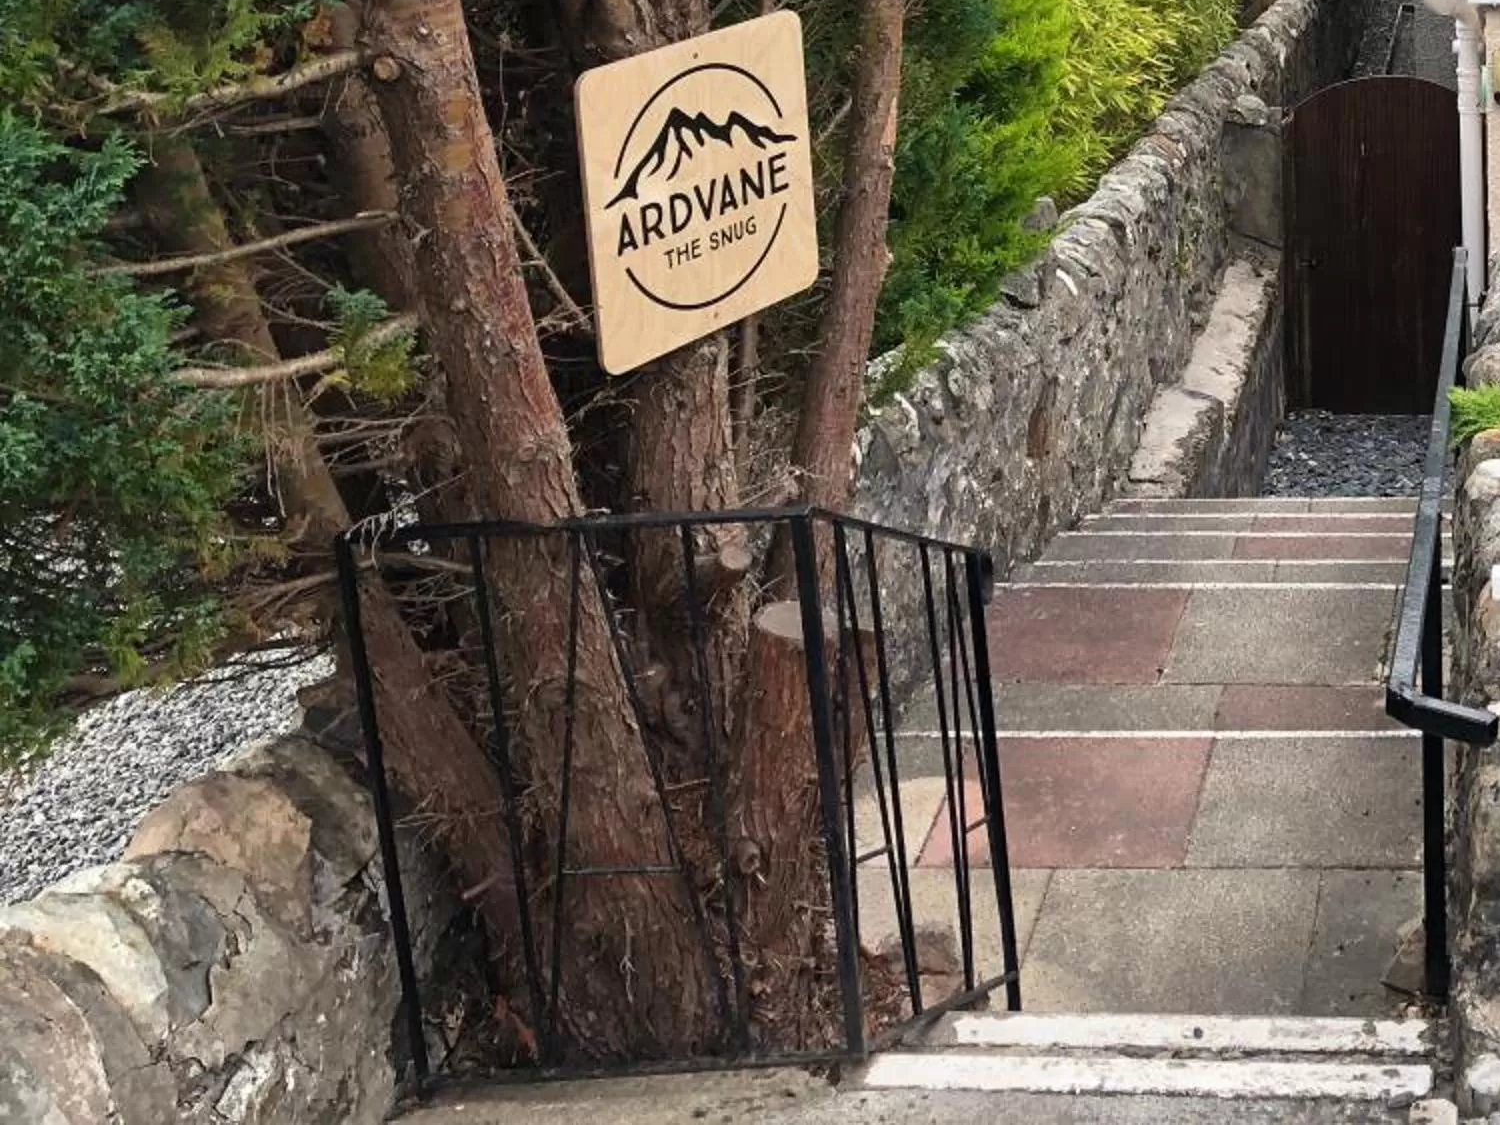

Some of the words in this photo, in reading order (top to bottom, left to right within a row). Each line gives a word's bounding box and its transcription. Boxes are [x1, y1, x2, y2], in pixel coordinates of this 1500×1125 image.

[617, 152, 789, 256] ARDVANE
[663, 238, 703, 269] THE
[709, 216, 757, 251] SNUG
